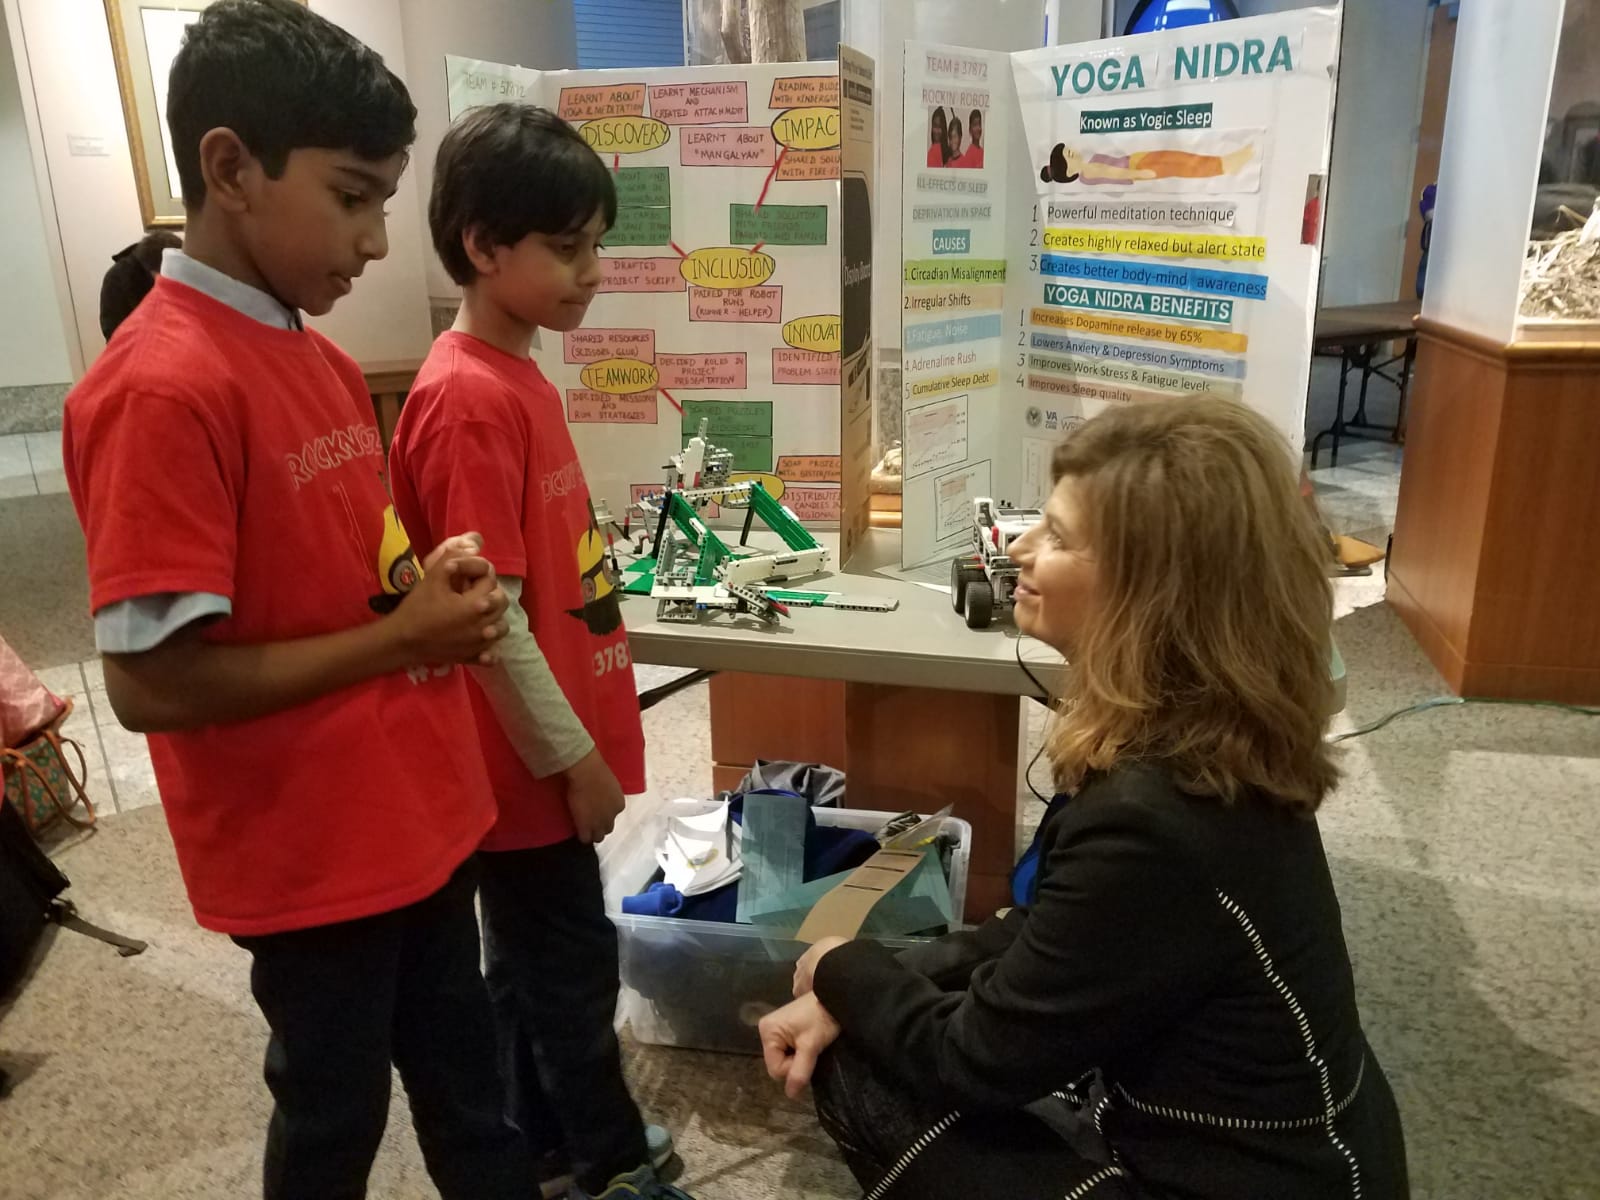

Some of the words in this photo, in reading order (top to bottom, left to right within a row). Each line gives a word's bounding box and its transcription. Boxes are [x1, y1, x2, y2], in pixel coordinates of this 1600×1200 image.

[926, 55, 952, 73] TEAM
[1050, 55, 1146, 98] YOGA
[1174, 35, 1293, 81] NIDRA
[567, 93, 603, 106] LEARNT
[609, 90, 641, 102] ABOUT
[653, 88, 685, 99] LEARNT
[689, 85, 739, 97] MECHANISM
[685, 98, 700, 106] AND
[654, 108, 688, 119] CREATED
[694, 106, 744, 117] ATTACHMENT
[1079, 116, 1120, 131] Known
[1123, 116, 1137, 128] as
[1140, 112, 1172, 129] Yogic
[1176, 109, 1212, 127] Sleep
[583, 121, 669, 147] DISCOVERY
[687, 133, 727, 145] LEARNT
[736, 132, 765, 145] ABOUT
[781, 167, 805, 177] WITH
[957, 180, 967, 192] OF
[968, 181, 988, 194] SLEEP
[912, 206, 960, 220] DEPRIVATION
[961, 206, 969, 219] IN
[970, 205, 992, 218] SPACE
[1047, 204, 1098, 220] Powerful
[1100, 206, 1166, 220] meditation
[1170, 206, 1235, 224] technique
[933, 236, 967, 252] CAUSES
[1043, 232, 1085, 247] Creates
[1087, 233, 1121, 253] highly
[1124, 236, 1169, 252] relaxed
[1172, 239, 1193, 254] but
[1196, 240, 1227, 255] alert
[1231, 242, 1265, 257] state
[613, 259, 657, 271] DRAFTED
[690, 256, 775, 280] INCLUSION
[601, 276, 639, 288] PROJECT
[951, 266, 1007, 284] Misalignment
[1040, 258, 1081, 275] Creates
[1083, 262, 1120, 280] better
[1122, 264, 1188, 286] body-mind
[1196, 274, 1267, 297] awareness
[749, 288, 779, 300] ROBOT
[948, 291, 972, 307] Shifts
[1046, 285, 1090, 305] YOGA
[1095, 290, 1145, 311] NIDRA
[1150, 295, 1230, 320] BENEFITS
[1032, 311, 1074, 324] Increases
[1076, 316, 1125, 333] Dopamine
[1126, 322, 1163, 338] release
[1165, 328, 1178, 342] by
[1180, 330, 1203, 343] 65%
[571, 333, 604, 344] SHARED
[778, 352, 834, 363] IDENTIFIED
[957, 350, 977, 364] Rush
[1032, 336, 1064, 350] Lowers
[1066, 341, 1100, 356] Anxiety
[1102, 344, 1110, 356] &
[1112, 346, 1167, 365] Depression
[1170, 353, 1225, 373] Symptoms
[584, 366, 657, 389] TEAMWORK
[777, 366, 812, 377] PROBLEM
[1031, 355, 1071, 372] Improves
[1073, 361, 1099, 376] Work
[1101, 366, 1129, 380] Stress
[1131, 369, 1139, 381] &
[1142, 371, 1179, 388] Fatigue
[1181, 377, 1211, 393] levels
[912, 379, 950, 396] Cumulative
[951, 374, 971, 388] Sleep
[972, 372, 990, 385] Debt
[1030, 377, 1070, 394] Improves
[1072, 383, 1097, 398] Sleep
[1099, 388, 1132, 402] quality
[1045, 411, 1058, 422] VA
